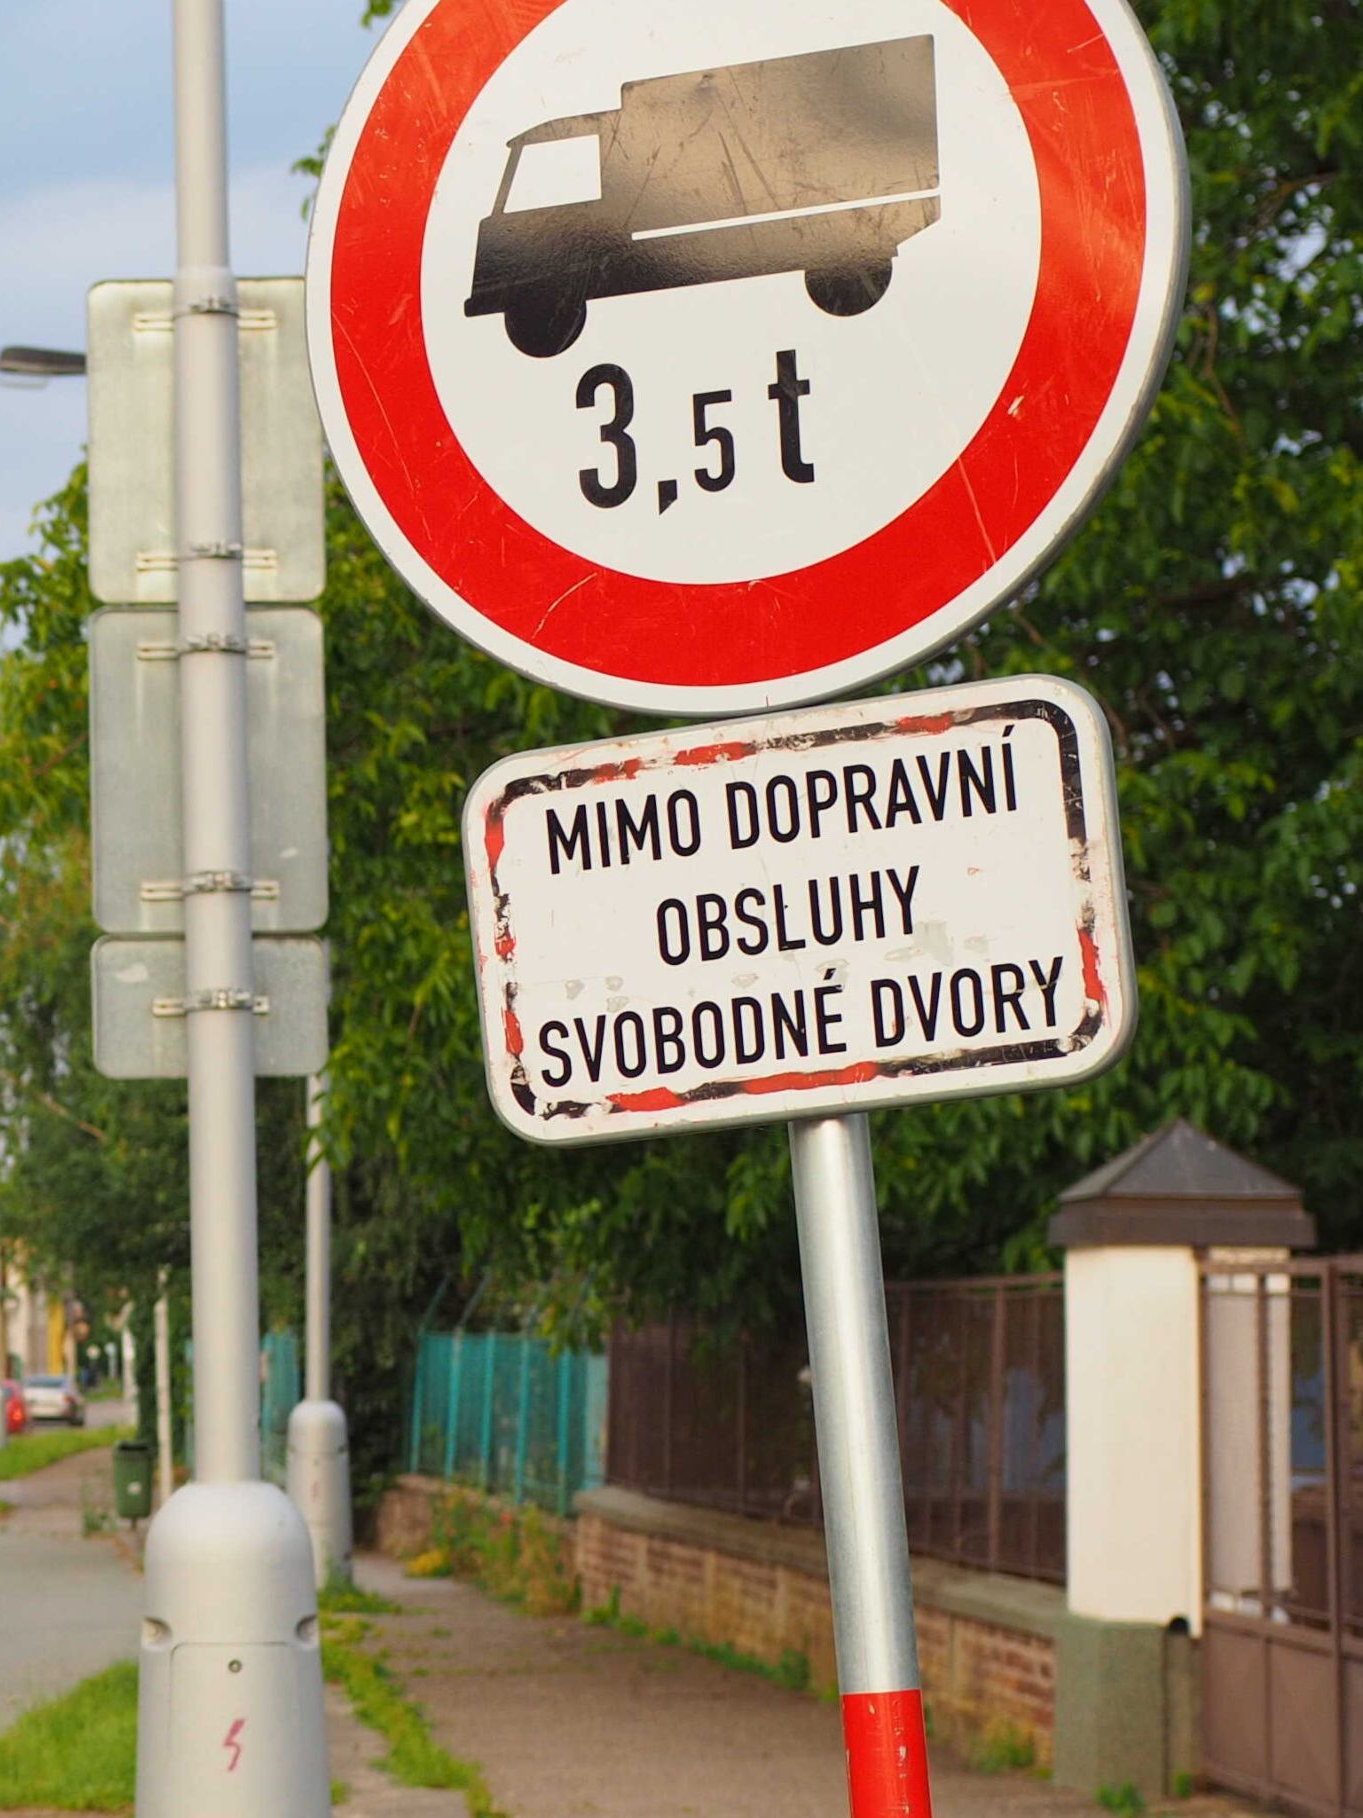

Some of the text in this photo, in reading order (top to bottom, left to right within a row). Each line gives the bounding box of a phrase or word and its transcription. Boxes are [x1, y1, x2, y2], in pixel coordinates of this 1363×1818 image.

[575, 348, 816, 516] 3,5 t
[545, 724, 1018, 875] MIMO DOPRAVNÍ
[655, 864, 921, 967] OBSLUHY
[538, 955, 1065, 1089] SVOBODNÉ DVORY
